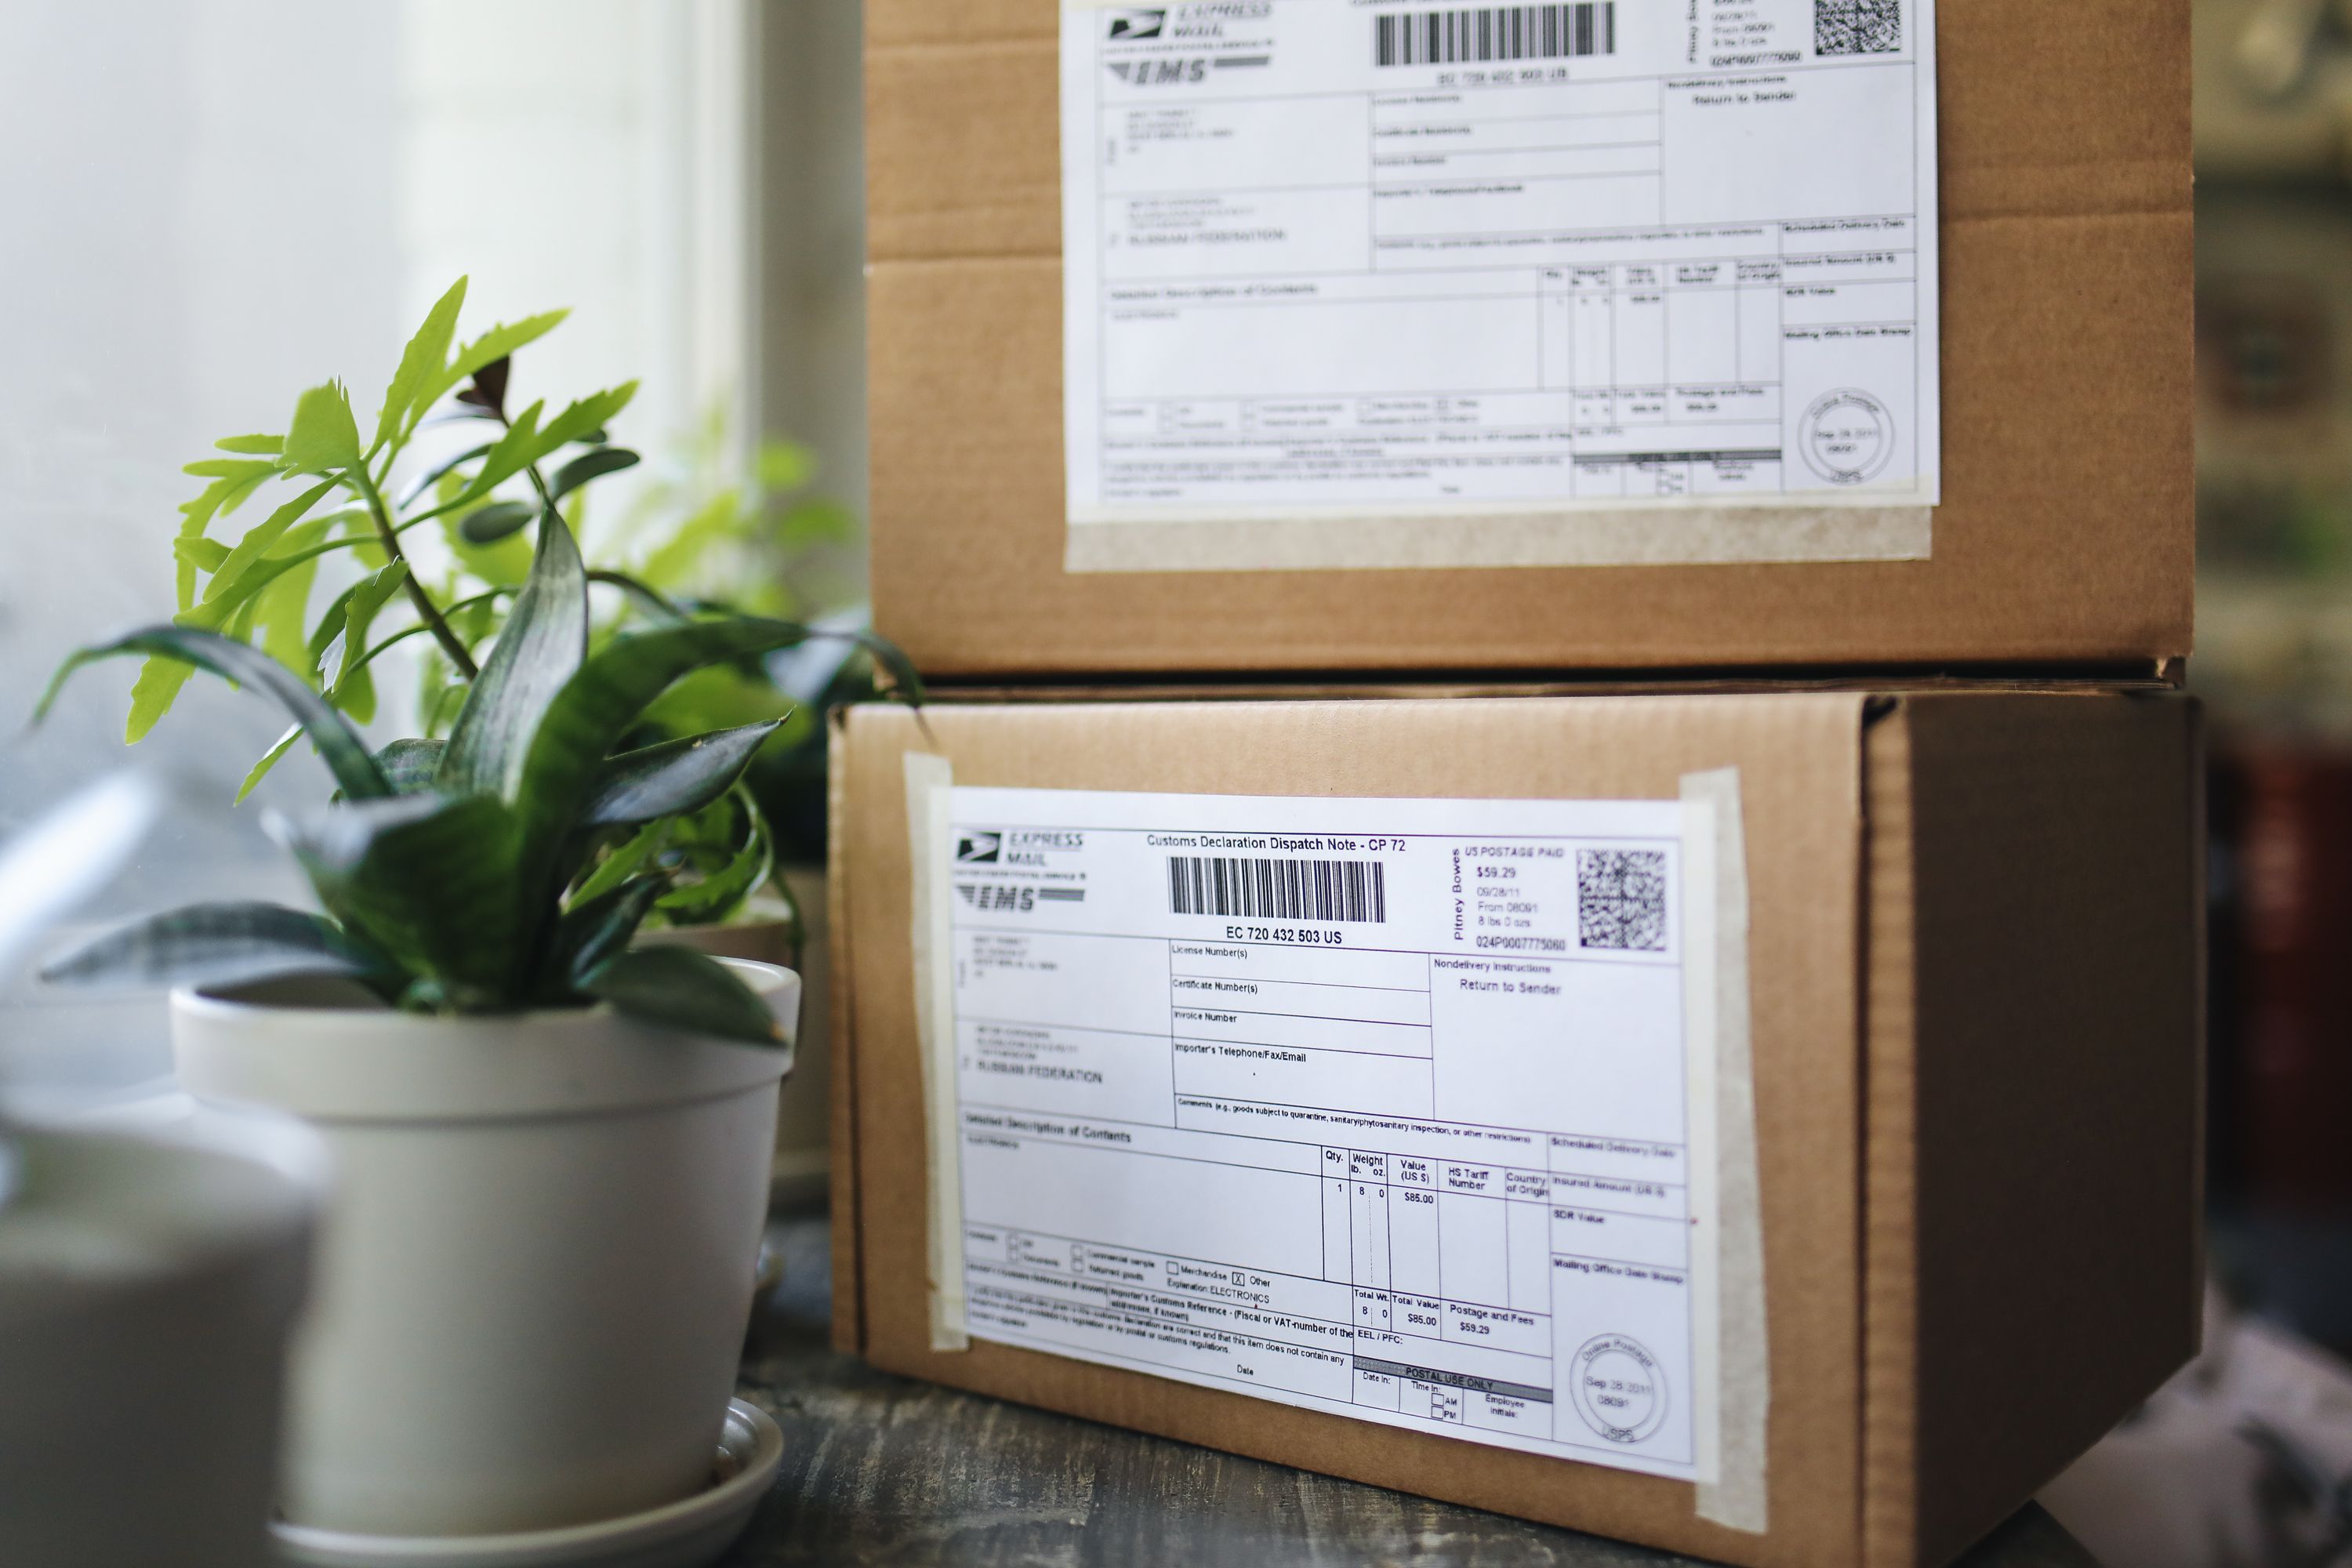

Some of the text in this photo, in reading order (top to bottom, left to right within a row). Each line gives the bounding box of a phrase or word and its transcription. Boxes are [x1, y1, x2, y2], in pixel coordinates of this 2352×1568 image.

[1009, 833, 1083, 847] EXPRESS
[1147, 834, 1196, 847] Customs
[1200, 836, 1266, 849] Declaration
[1271, 837, 1323, 852] Dispatch
[1330, 839, 1356, 851] Note
[1369, 839, 1387, 851] CP
[1391, 840, 1406, 851] 72
[1465, 848, 1564, 858] US POSTAGE PAID
[1477, 866, 1516, 878] $59.29
[979, 885, 1034, 911] EMS
[1452, 848, 1464, 940] Pitney Bowes
[1477, 887, 1519, 897] 09/28/11
[1478, 902, 1503, 912] From
[1478, 916, 1484, 925] 8
[1488, 916, 1501, 926] lbs
[1226, 926, 1342, 944] EC 720 432 503 US
[1172, 945, 1247, 959] License Number(s)
[1434, 959, 1490, 971] Nondelivery
[1173, 979, 1258, 994] Certificate Number(s)
[1460, 979, 1561, 995] Return to Sender
[1174, 1011, 1237, 1022] Invoice Number
[1175, 1044, 1306, 1062] Importer's Telephone/Fax/Email
[1232, 1105, 1254, 1114] goods
[1256, 1107, 1280, 1117] subject
[1290, 1112, 1329, 1123] quarantine,
[1411, 1123, 1451, 1136] inspection,
[1069, 1125, 1079, 1136] of
[1326, 1150, 1344, 1162] Qty.
[1352, 1154, 1383, 1166] Weight
[1400, 1160, 1426, 1171] Value
[1373, 1167, 1385, 1177] oz.
[1448, 1167, 1490, 1180] HS Tariff
[1449, 1178, 1486, 1190] Number
[1506, 1172, 1546, 1186] Country
[1338, 1184, 1342, 1192] 1
[1359, 1186, 1385, 1198] 8 0
[1507, 1184, 1516, 1192] of
[1404, 1192, 1434, 1204] $85.00
[1181, 1265, 1227, 1280] Merchandise
[1250, 1276, 1270, 1287] Other
[1210, 1286, 1269, 1303] ELECTRONICS
[1355, 1289, 1390, 1302] Total Wt.
[1392, 1295, 1439, 1310] Total Value
[1382, 1309, 1388, 1319] 0
[1408, 1313, 1436, 1327] $85.00
[1450, 1305, 1534, 1326] Postage and Fees
[1234, 1309, 1261, 1322] (Fiscal
[1274, 1316, 1327, 1334] VAT-number
[1329, 1327, 1339, 1336] of
[1340, 1328, 1354, 1338] the
[1461, 1322, 1490, 1334] $59.29
[1358, 1330, 1375, 1341] EEL
[1382, 1334, 1403, 1345] PFC:
[1203, 1331, 1216, 1341] and
[1218, 1333, 1232, 1342] that
[1233, 1335, 1246, 1346] this
[1247, 1339, 1264, 1349] item
[1265, 1341, 1285, 1353] does
[1287, 1347, 1299, 1356] not
[1301, 1349, 1328, 1362] contain
[1330, 1356, 1345, 1366] any
[1236, 1364, 1254, 1375] Date
[1363, 1372, 1379, 1382] Date
[1406, 1367, 1494, 1389] POSTAL USE ONLY
[1586, 1376, 1606, 1389] Sep
[1411, 1381, 1429, 1391] Time
[1445, 1397, 1457, 1406] AM
[1486, 1394, 1525, 1409] Employee
[1444, 1410, 1457, 1419] PM
